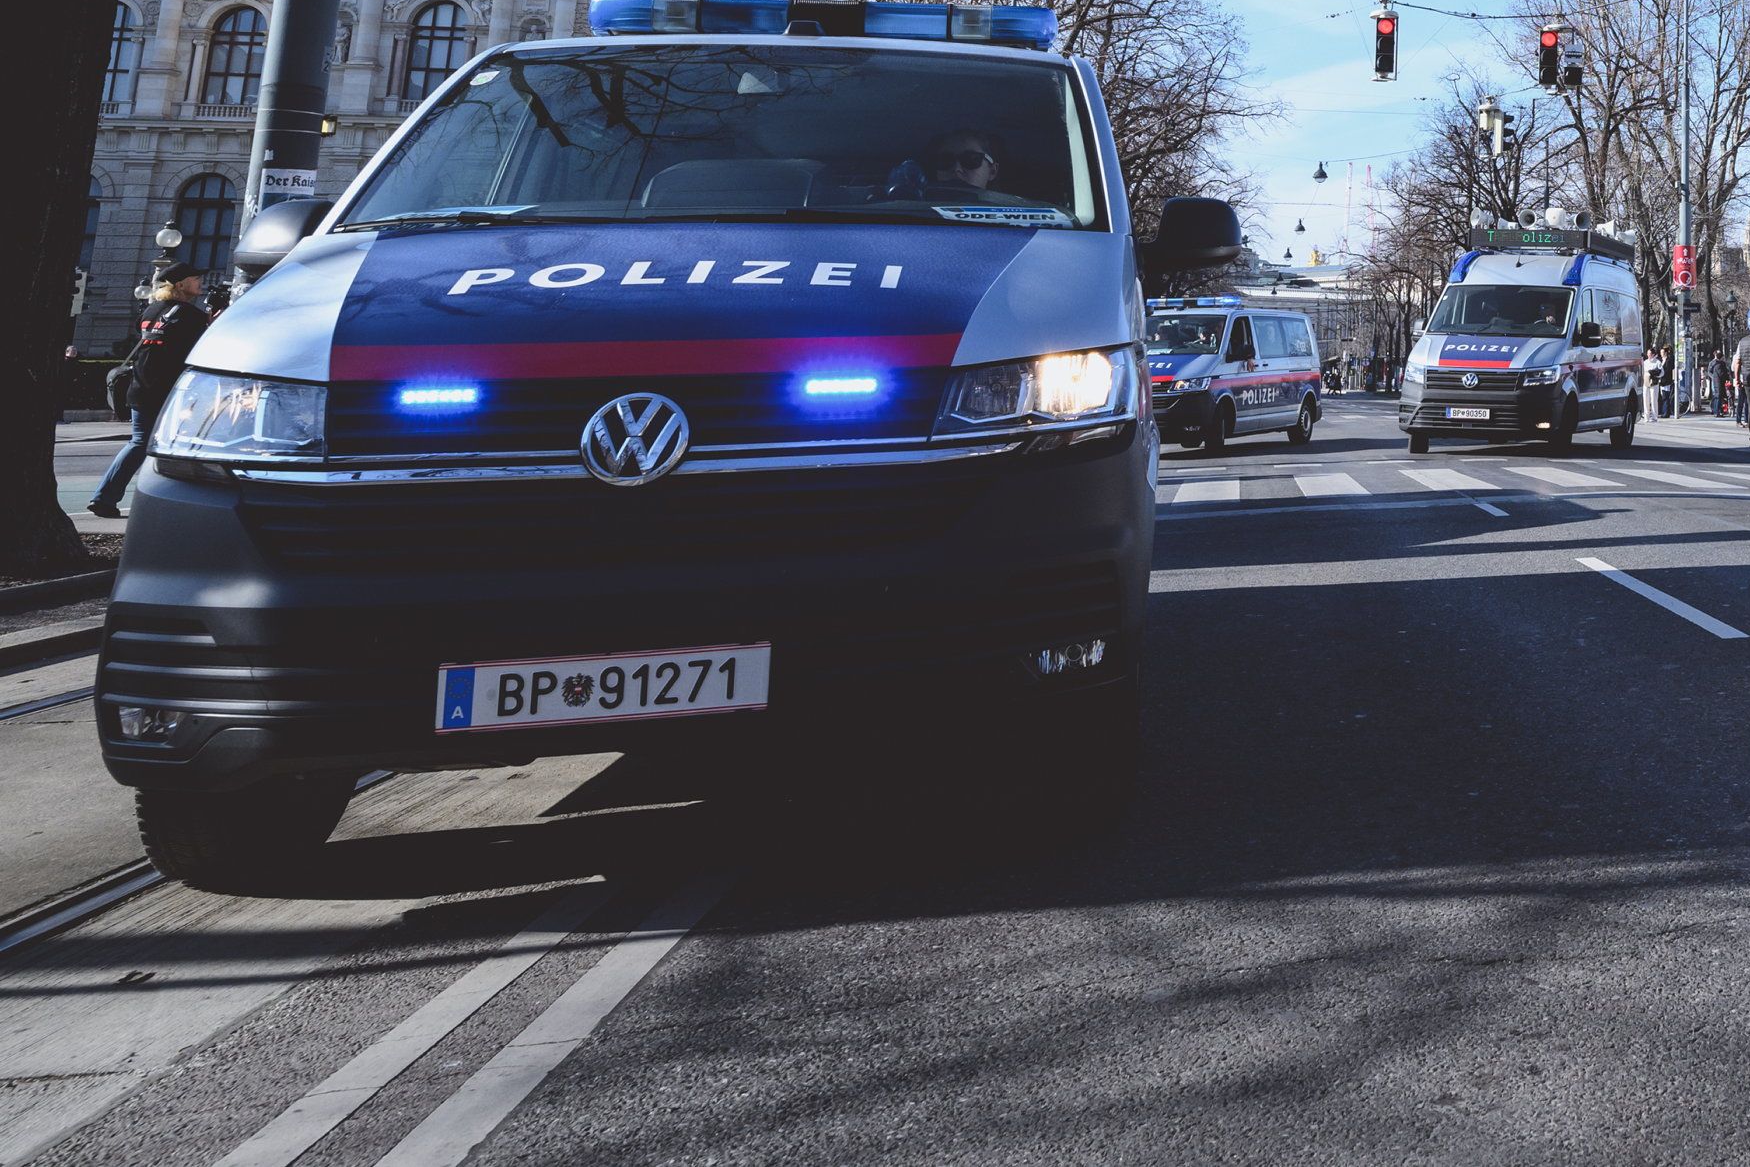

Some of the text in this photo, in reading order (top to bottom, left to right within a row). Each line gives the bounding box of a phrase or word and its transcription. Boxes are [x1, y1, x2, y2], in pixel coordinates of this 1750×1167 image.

[265, 174, 289, 186] Der
[447, 260, 903, 296] POLIZEI
[1444, 344, 1519, 354] POLIZEI
[1242, 387, 1276, 406] POLIZEI
[451, 705, 465, 720] A
